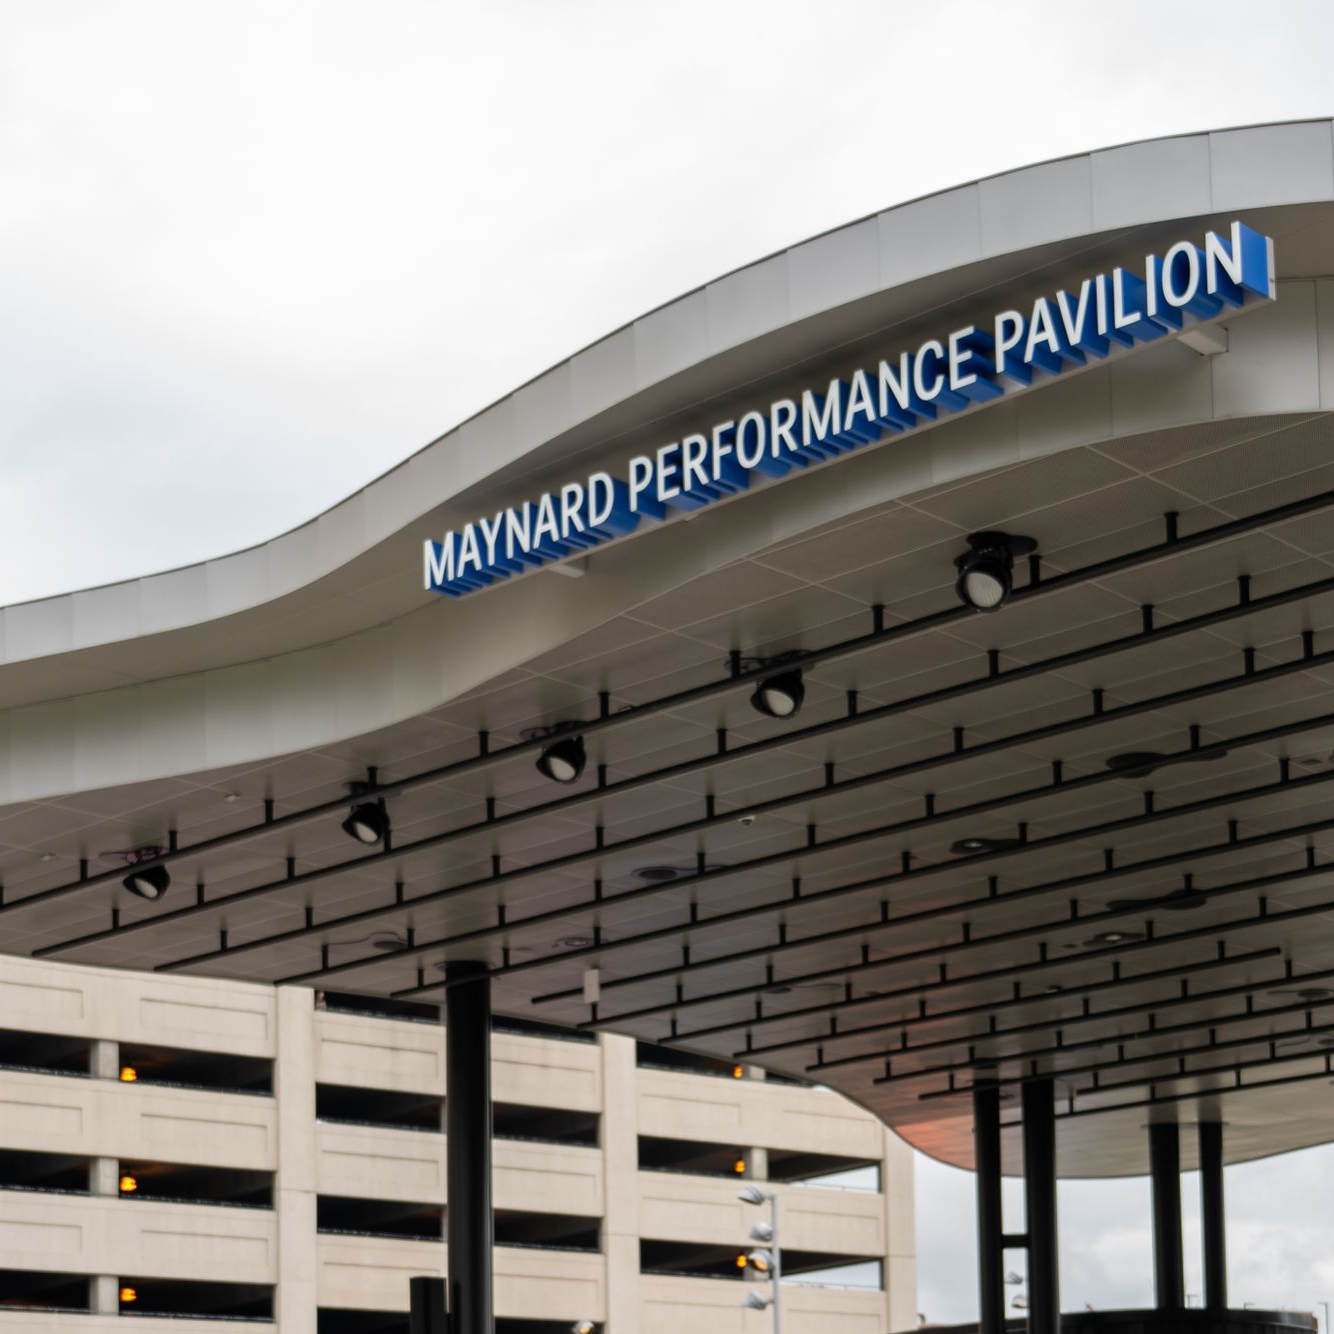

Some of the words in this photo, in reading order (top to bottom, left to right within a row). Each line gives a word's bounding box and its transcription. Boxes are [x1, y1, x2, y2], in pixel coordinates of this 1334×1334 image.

[424, 472, 615, 591] MAYNARD
[629, 325, 977, 513] PERFORMANCE
[994, 221, 1243, 374] PAVILION
